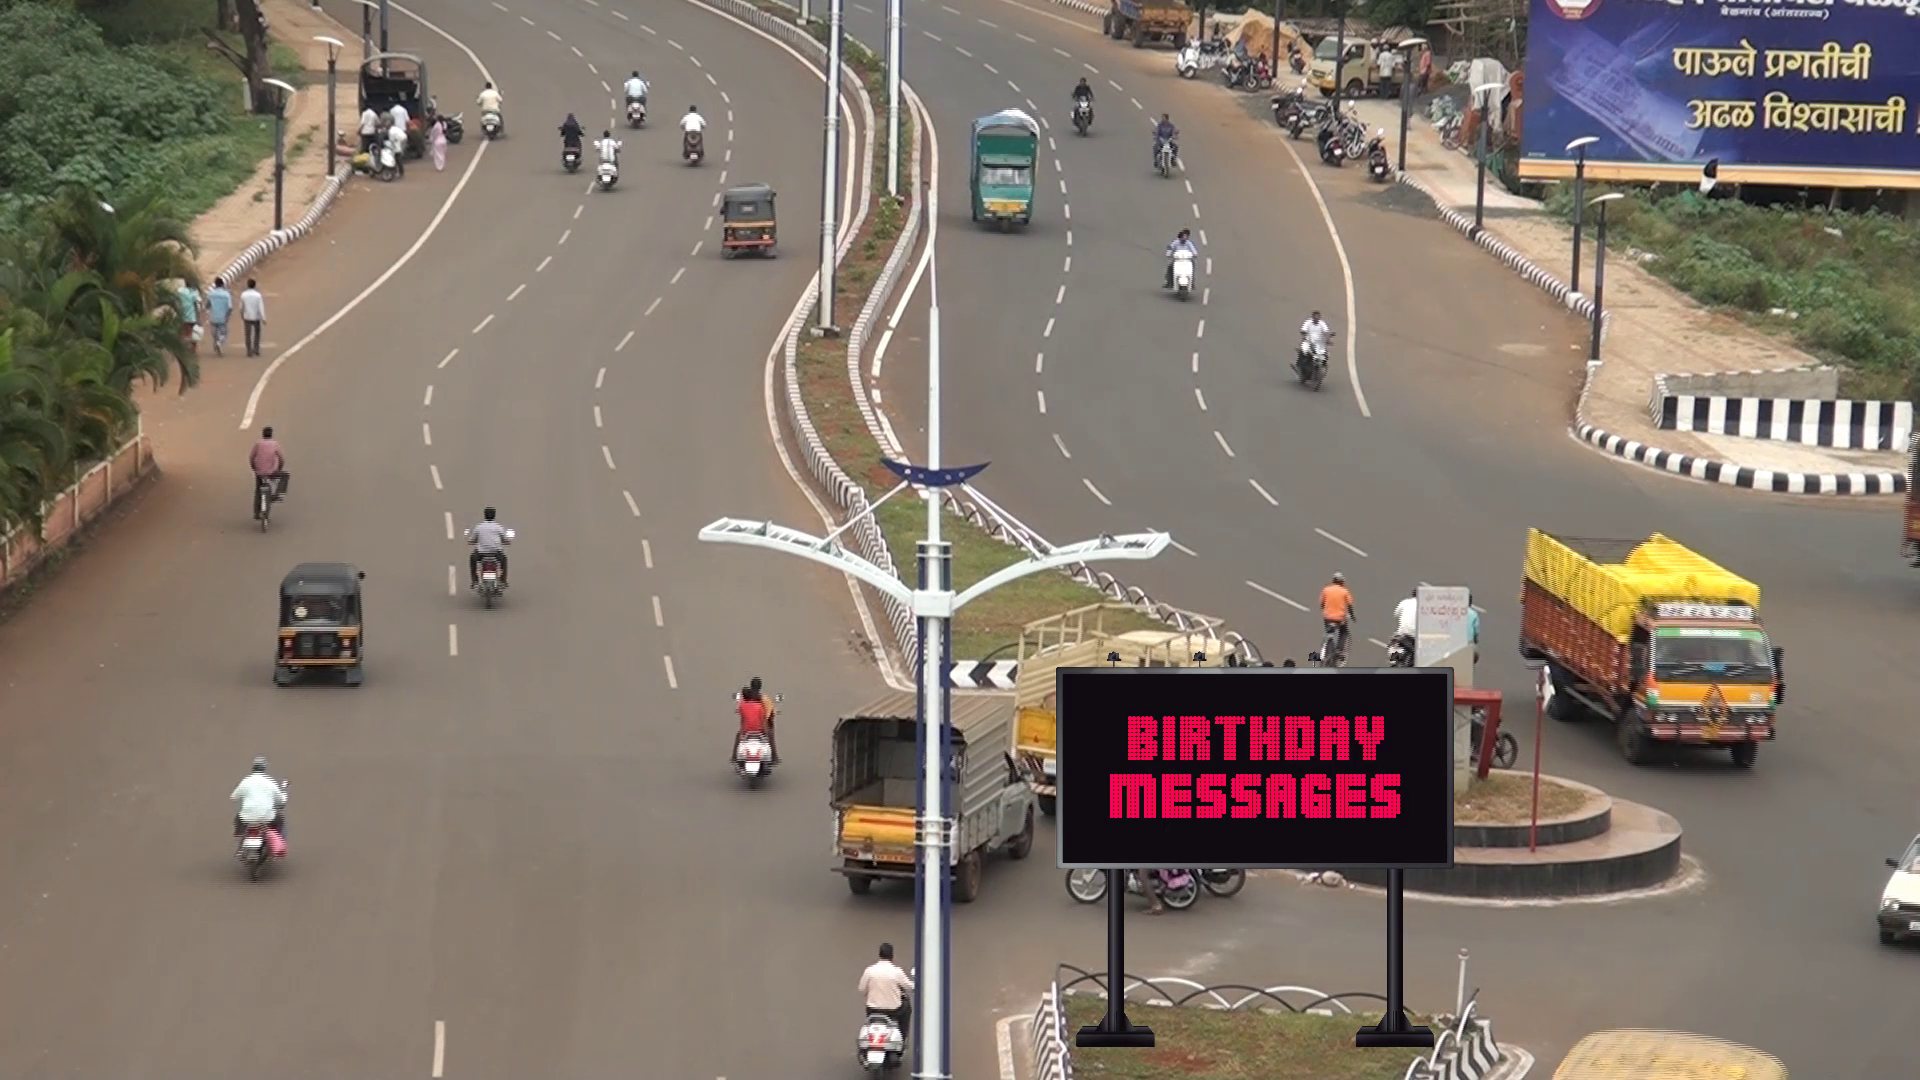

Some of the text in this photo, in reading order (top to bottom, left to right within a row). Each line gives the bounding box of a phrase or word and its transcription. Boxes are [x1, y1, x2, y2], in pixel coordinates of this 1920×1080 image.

[1673, 39, 1872, 80] पाऊले प्रगतीची
[1684, 99, 1756, 129] अढळ
[1763, 91, 1906, 133] विश्वासाची
[1127, 716, 1385, 761] BIRTHDAY
[1109, 773, 1401, 819] MESSAGES
